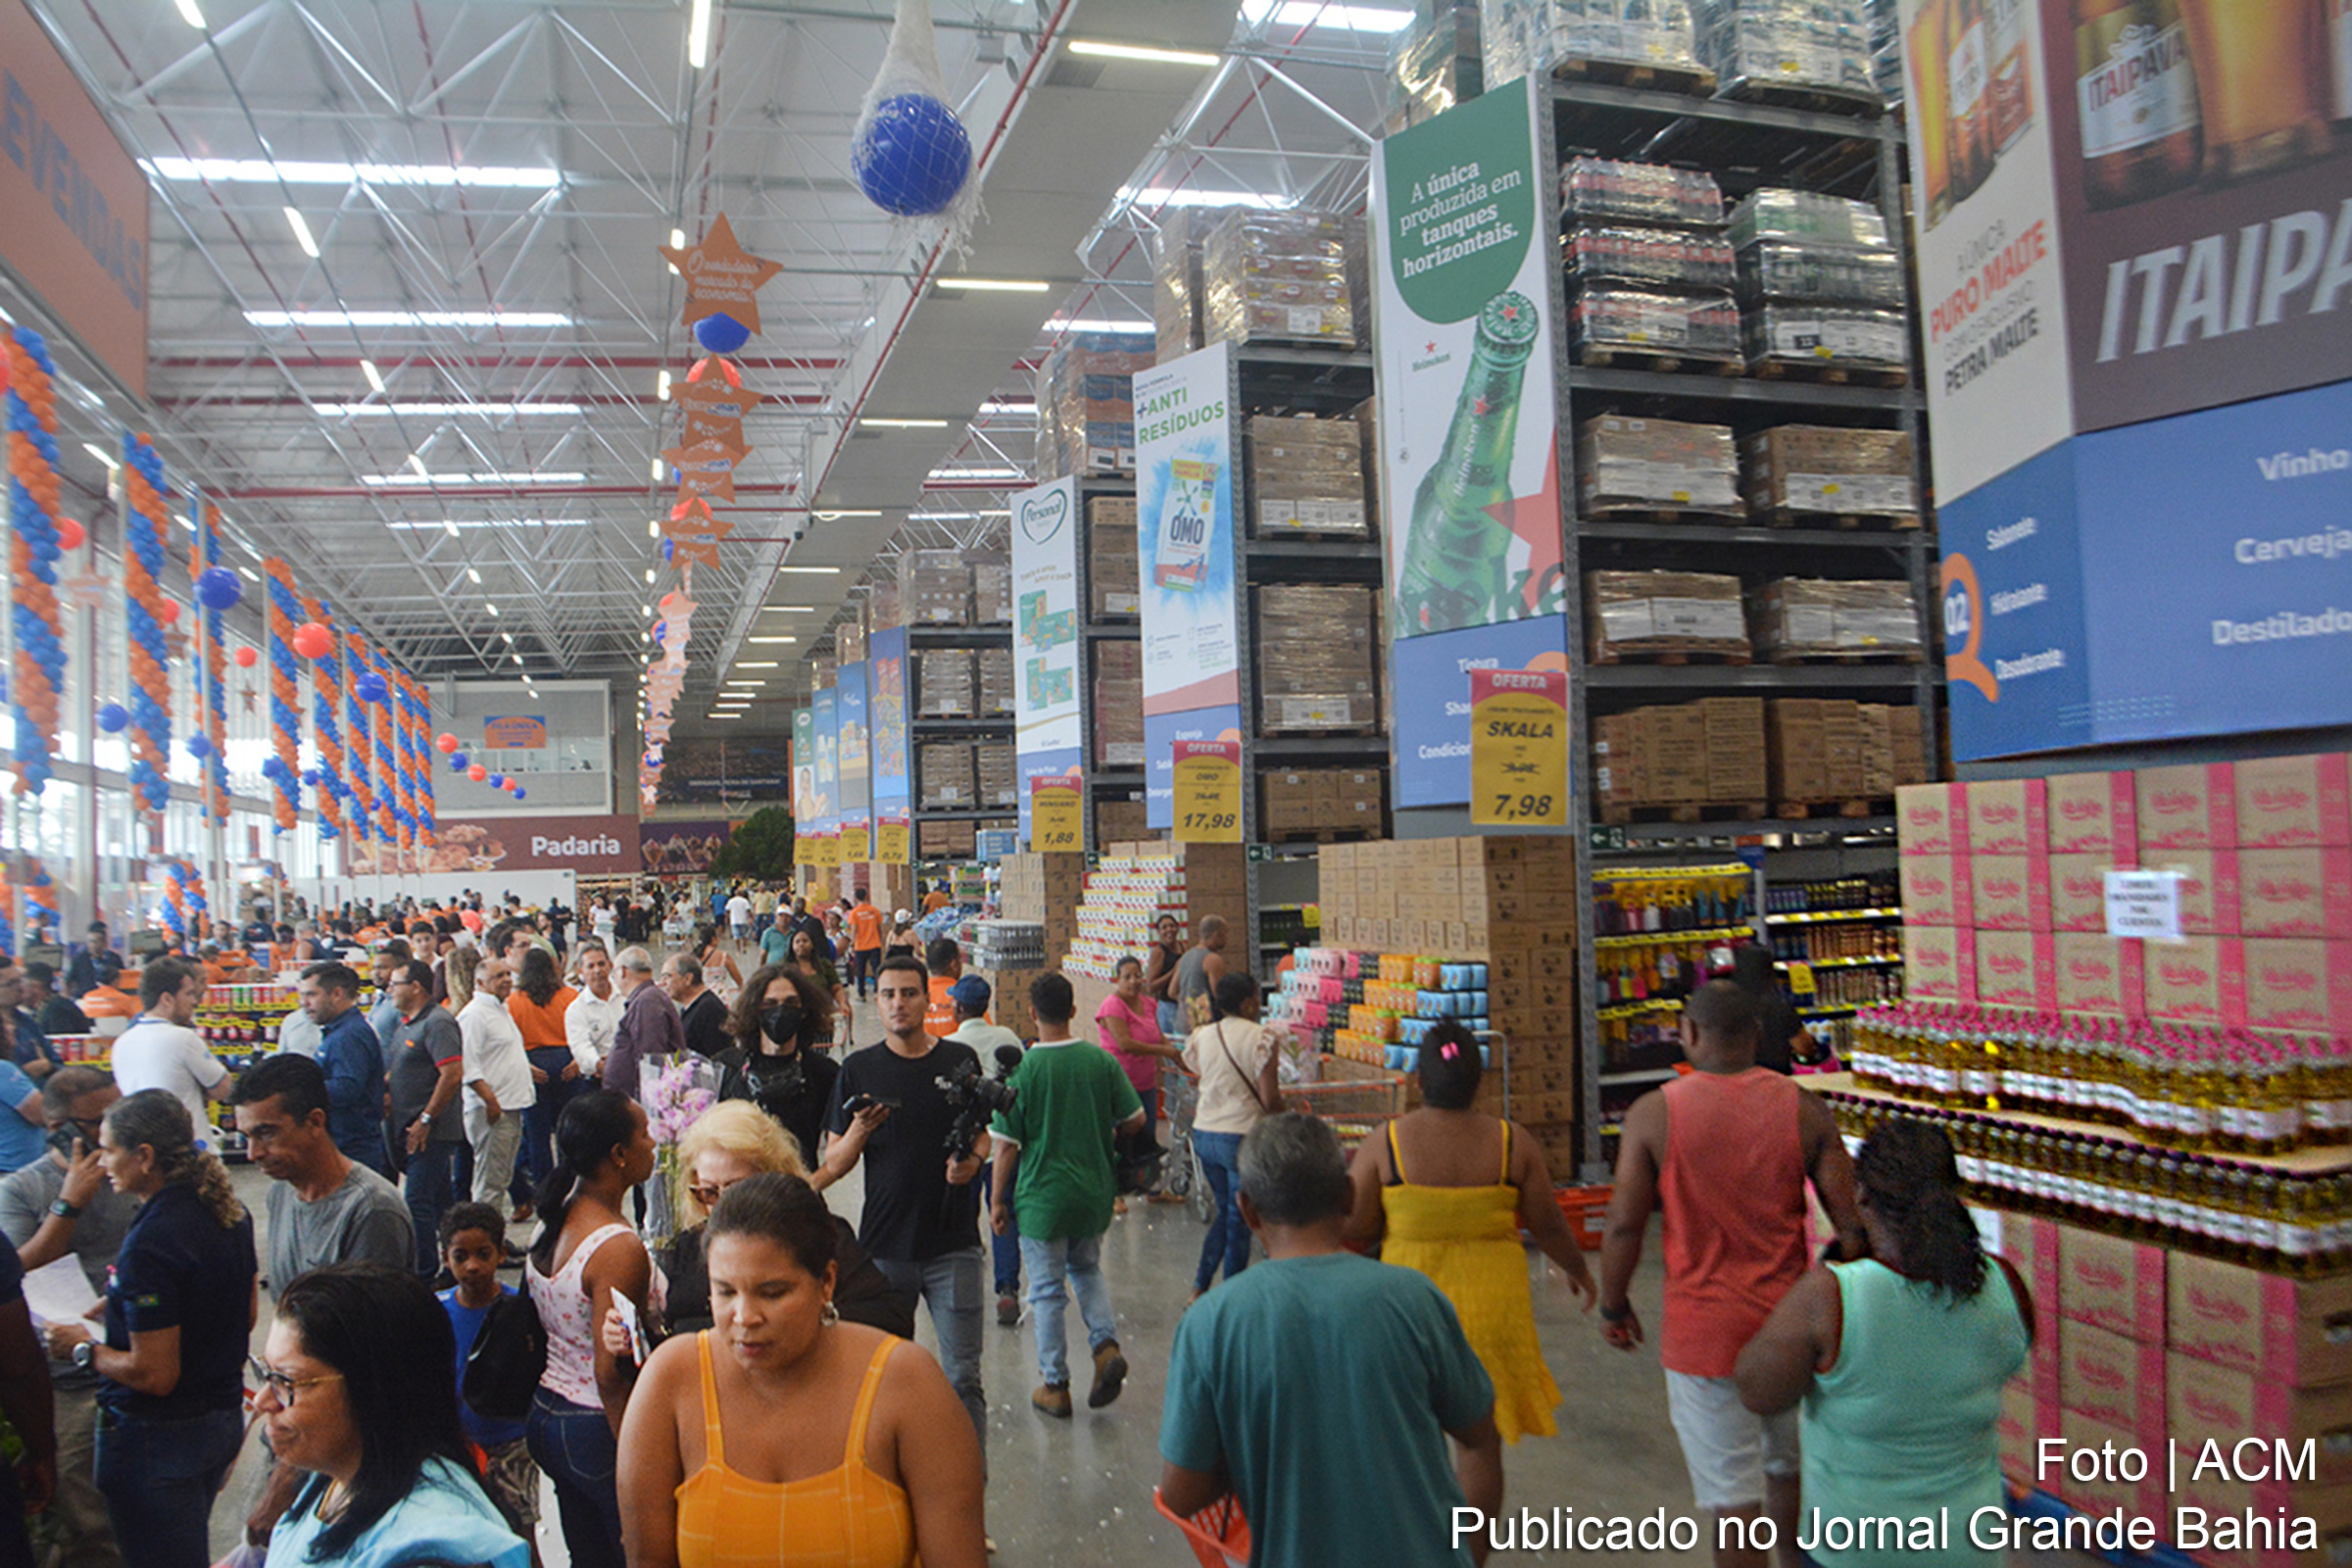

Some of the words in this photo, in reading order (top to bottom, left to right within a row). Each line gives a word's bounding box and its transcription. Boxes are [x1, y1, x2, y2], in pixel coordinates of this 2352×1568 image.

[2088, 30, 2185, 113] ITAIPAVA
[1399, 182, 1489, 238] produzida
[1491, 170, 1523, 196] em
[1410, 182, 1424, 205] A
[1427, 162, 1481, 198] única
[1420, 203, 1498, 248] tanques
[1401, 221, 1519, 280] horizontais.
[1930, 275, 1981, 344] PURO
[1983, 219, 2047, 302] MALTE
[1944, 345, 1988, 396] PETRA
[1988, 307, 2039, 366] MALTE
[1139, 401, 1224, 445] RESÍDUOS
[1170, 514, 1204, 545] OMO
[1943, 592, 1971, 636] 02
[1492, 673, 1548, 689] OFERTA
[1187, 743, 1226, 754] OFERTA
[1487, 720, 1554, 739] SKALA
[1184, 812, 1237, 832] 17,98
[1494, 794, 1552, 820] 7,98
[531, 833, 621, 858] Padaria
[1045, 831, 1075, 846] 1,88
